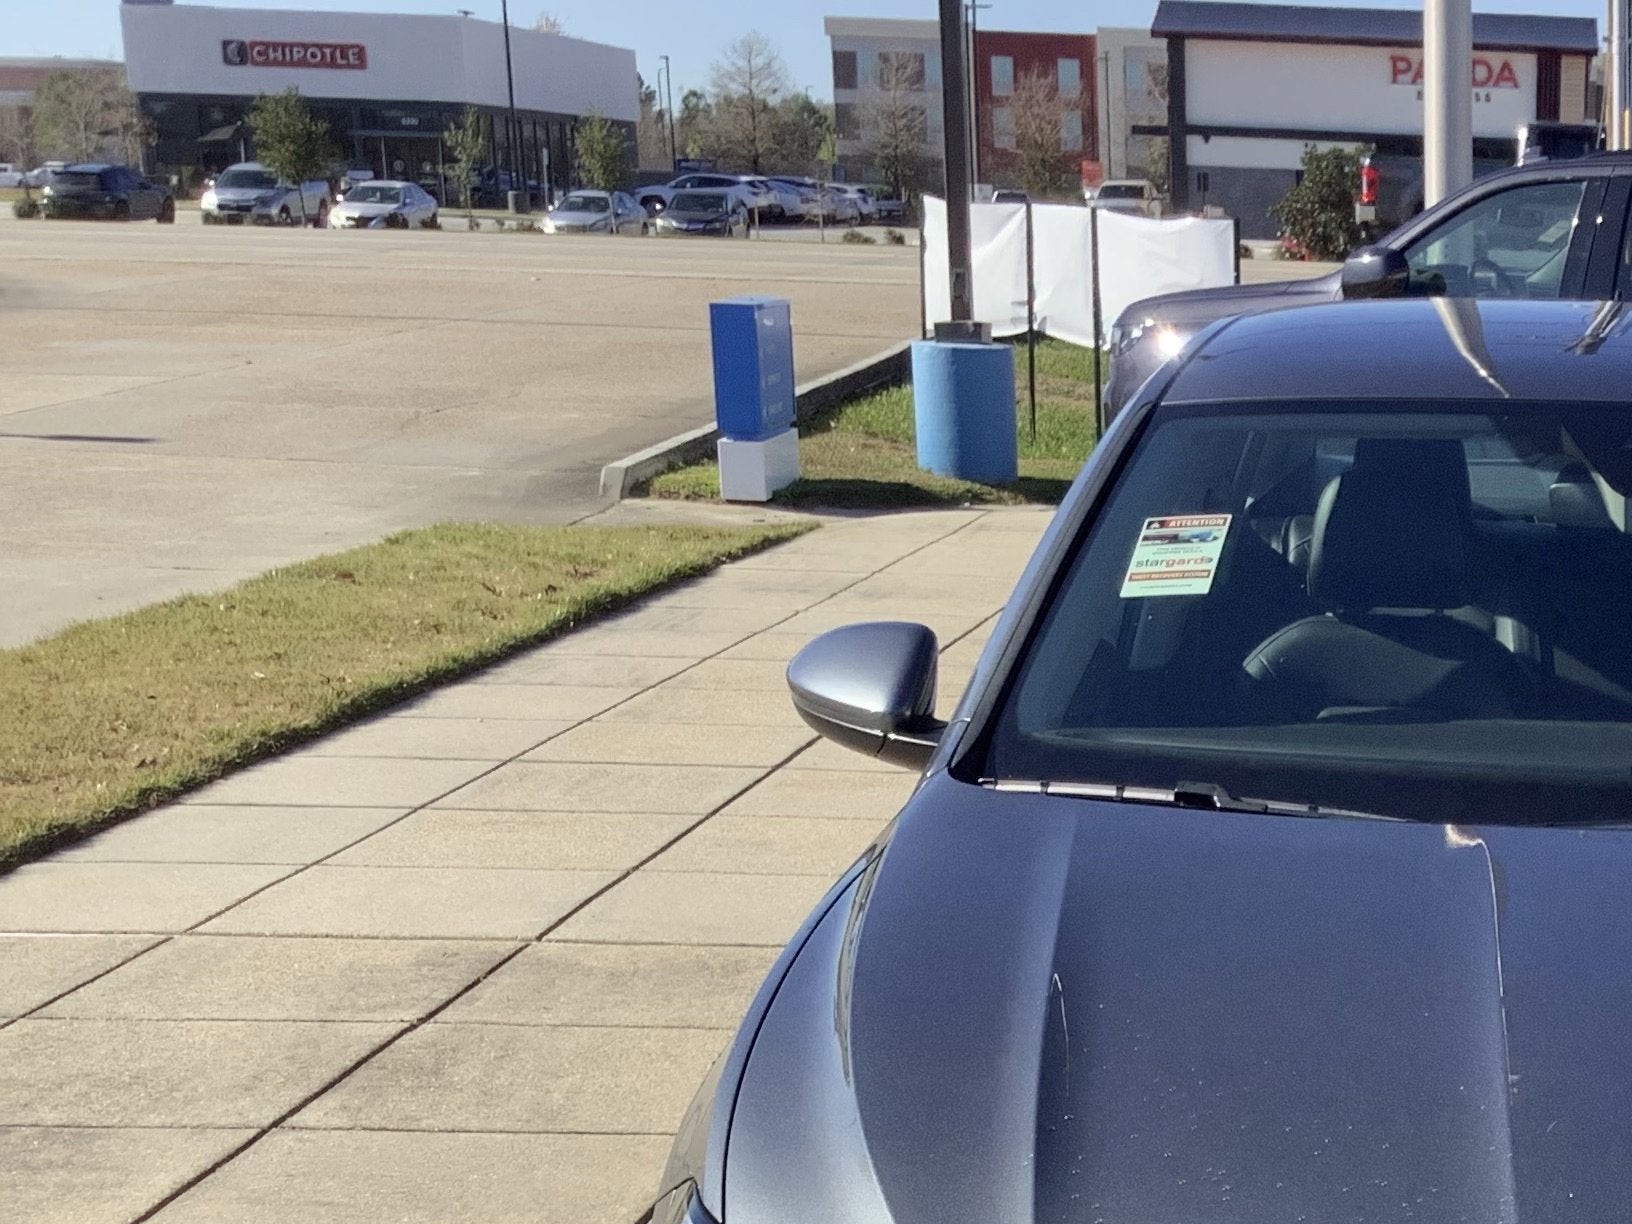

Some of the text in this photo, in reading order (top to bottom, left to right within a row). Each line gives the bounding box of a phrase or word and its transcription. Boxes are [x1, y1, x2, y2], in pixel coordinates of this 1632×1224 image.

[252, 45, 361, 64] CHIPOTLE
[1390, 55, 1519, 88] PADA
[1168, 518, 1225, 528] ATTENTION
[1135, 555, 1206, 568] stargard
